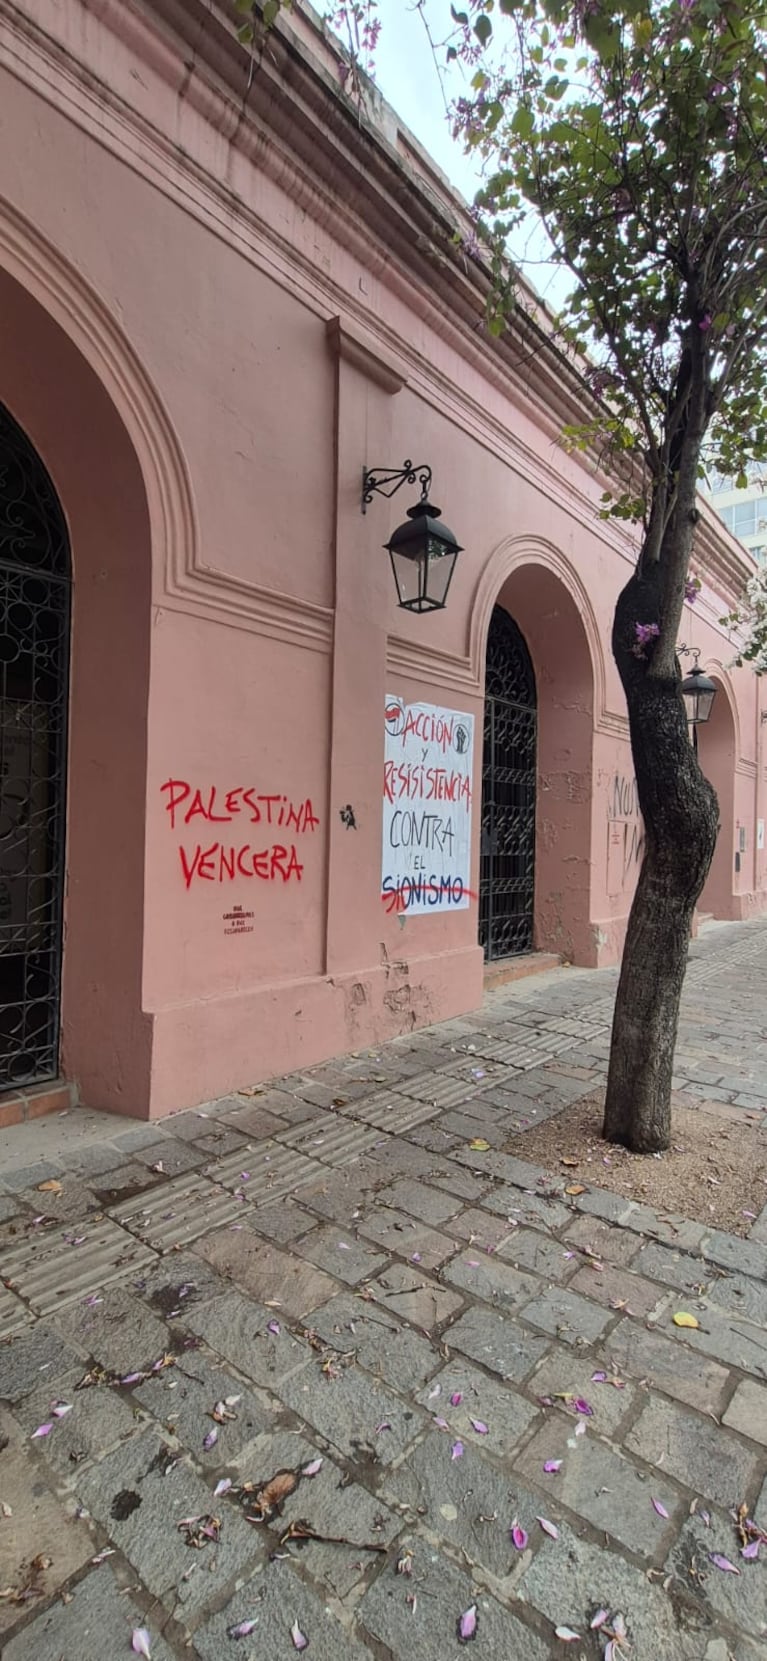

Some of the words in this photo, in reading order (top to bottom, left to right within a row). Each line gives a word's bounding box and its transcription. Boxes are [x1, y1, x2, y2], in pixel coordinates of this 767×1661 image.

[402, 710, 454, 753] ACCIÓN
[390, 810, 455, 857] CONTRA
[178, 842, 304, 890] VENCERA
[414, 856, 426, 870] EL
